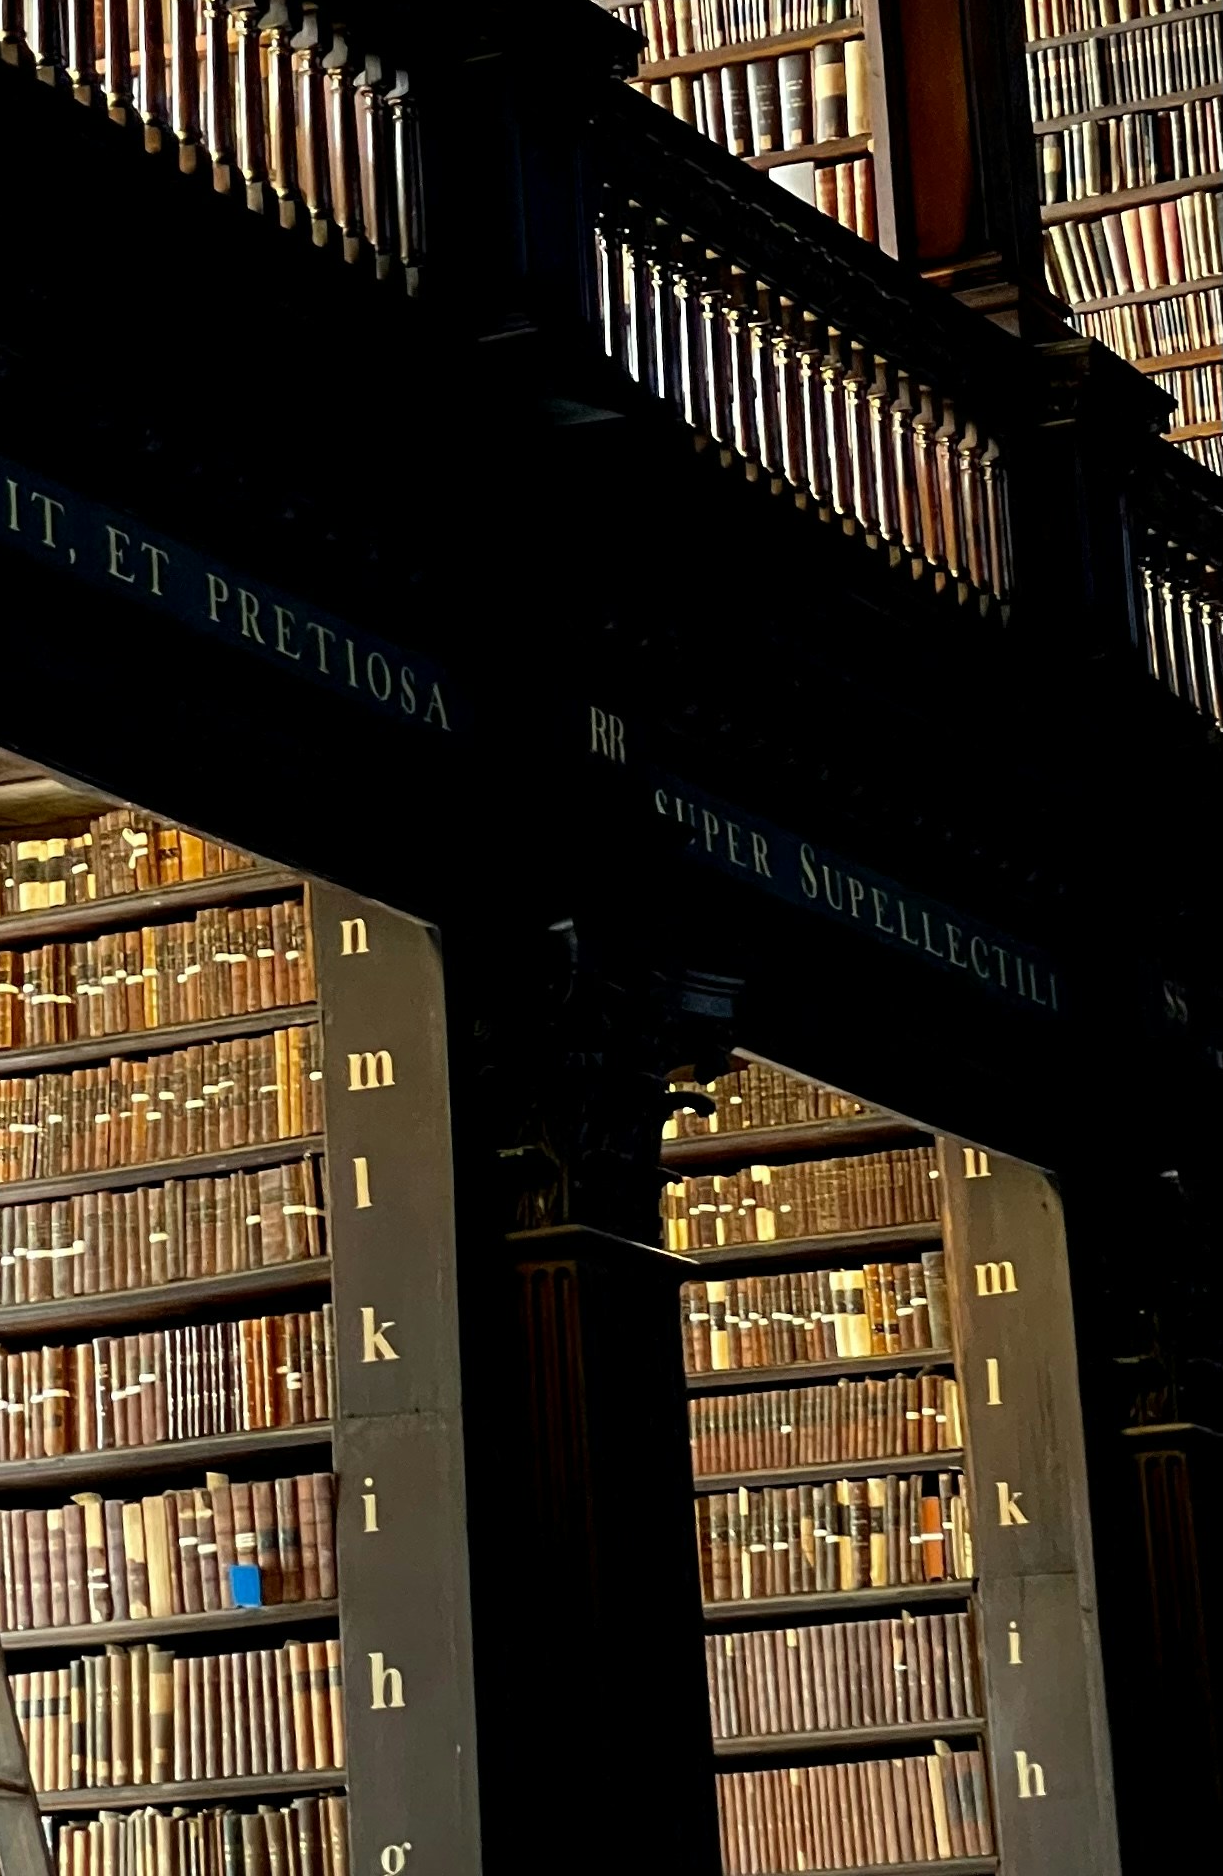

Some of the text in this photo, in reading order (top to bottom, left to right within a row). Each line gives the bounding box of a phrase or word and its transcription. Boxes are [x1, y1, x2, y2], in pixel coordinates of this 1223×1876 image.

[104, 524, 171, 597] ET
[204, 571, 454, 732] PRETIOSA
[589, 705, 627, 765] RR
[340, 917, 371, 956] n
[798, 842, 1059, 1011] SUPELLECTILI
[347, 1049, 397, 1092] m
[974, 1260, 1019, 1298] m
[359, 1306, 402, 1364] k
[360, 1476, 380, 1534] i
[995, 1480, 1030, 1527] k
[1008, 1620, 1023, 1666] i
[368, 1651, 407, 1711] h
[1014, 1749, 1048, 1799] h
